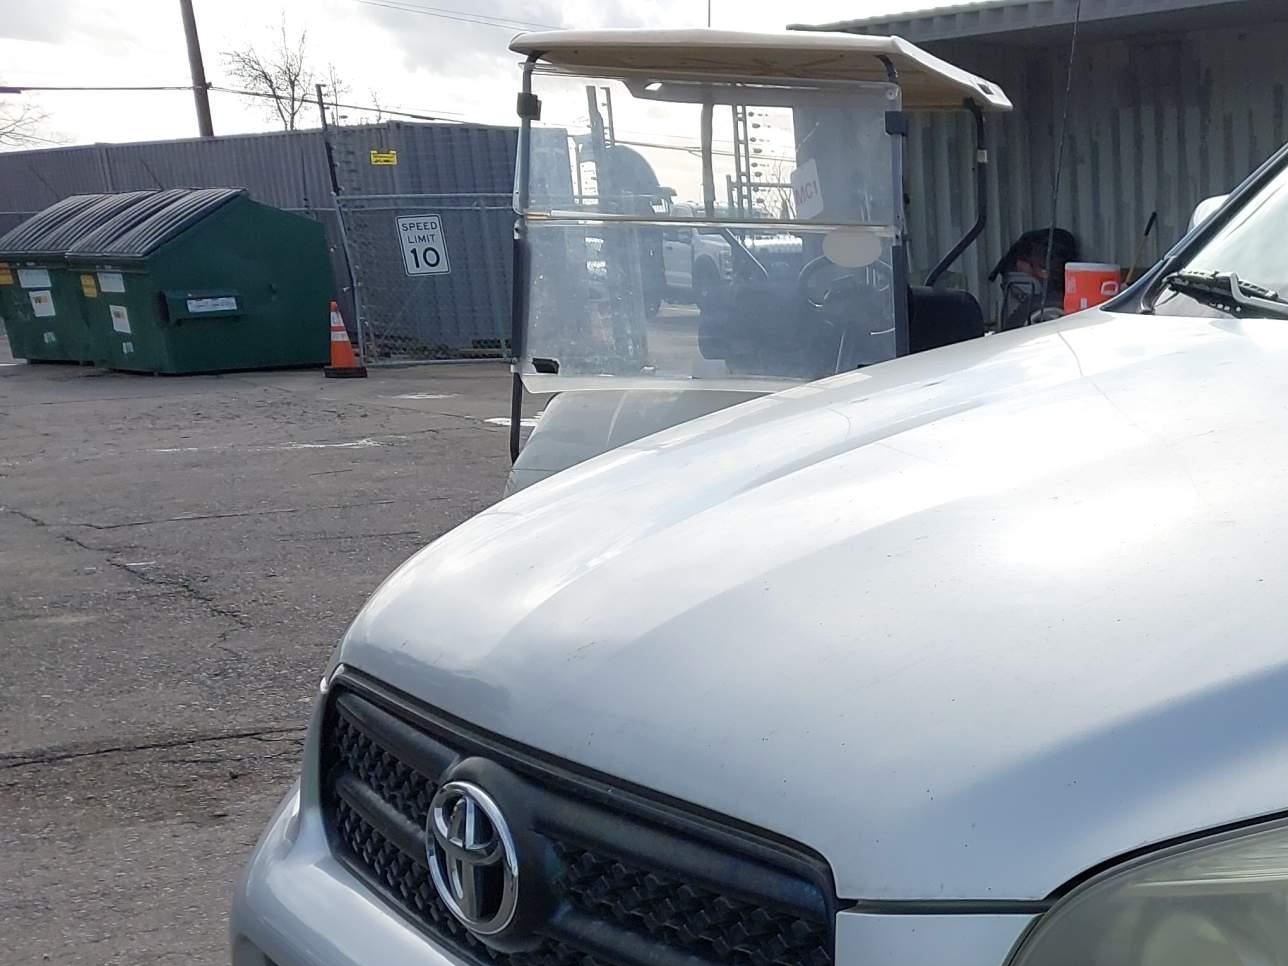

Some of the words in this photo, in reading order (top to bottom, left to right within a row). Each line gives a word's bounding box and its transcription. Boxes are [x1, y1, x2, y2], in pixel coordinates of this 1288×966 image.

[401, 221, 438, 232] SPEED
[407, 234, 436, 244] LIMIT
[410, 247, 440, 268] 10
